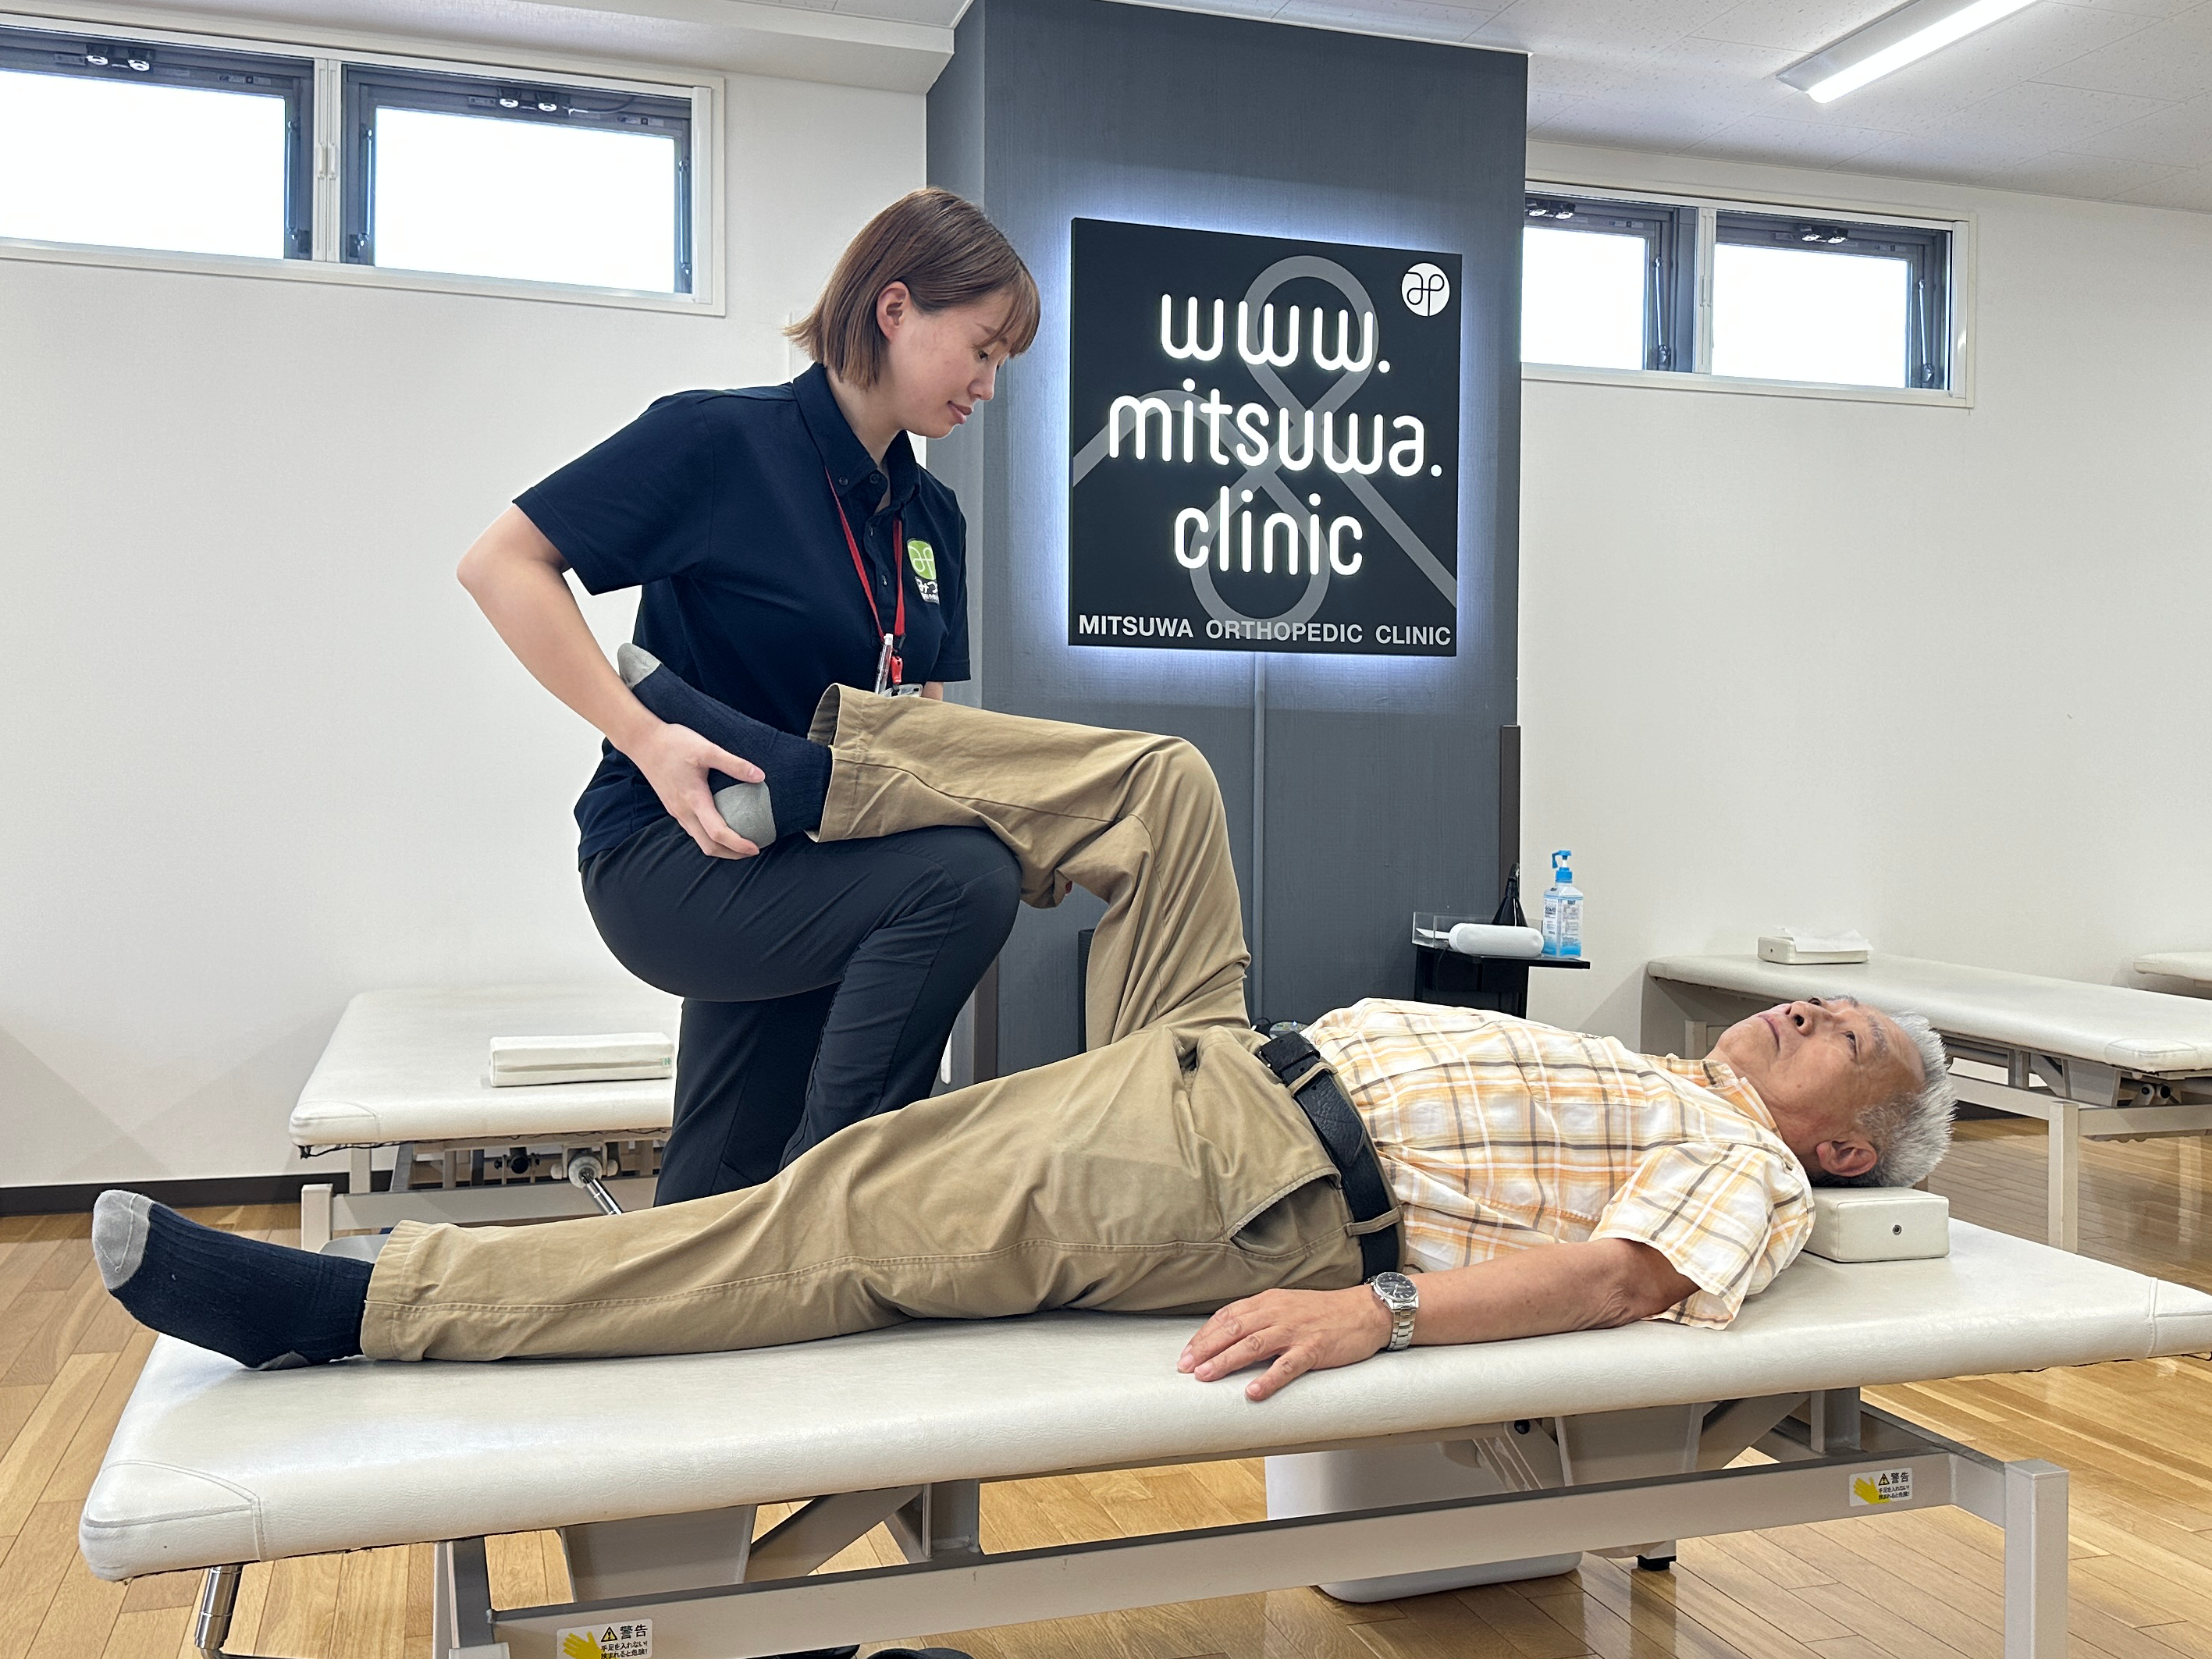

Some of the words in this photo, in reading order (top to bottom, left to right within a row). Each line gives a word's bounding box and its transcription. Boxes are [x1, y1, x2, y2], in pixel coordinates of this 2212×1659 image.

[1161, 293, 1391, 373] www.
[1109, 378, 1442, 477] mitsuwa.
[1175, 485, 1363, 576] clinic
[1079, 614, 1194, 638] MITSUWA
[1206, 620, 1363, 644] ORTHOPEDIC
[1375, 625, 1451, 646] CLINIC
[1890, 1471, 1910, 1484] 警告
[620, 1623, 649, 1640] 警告
